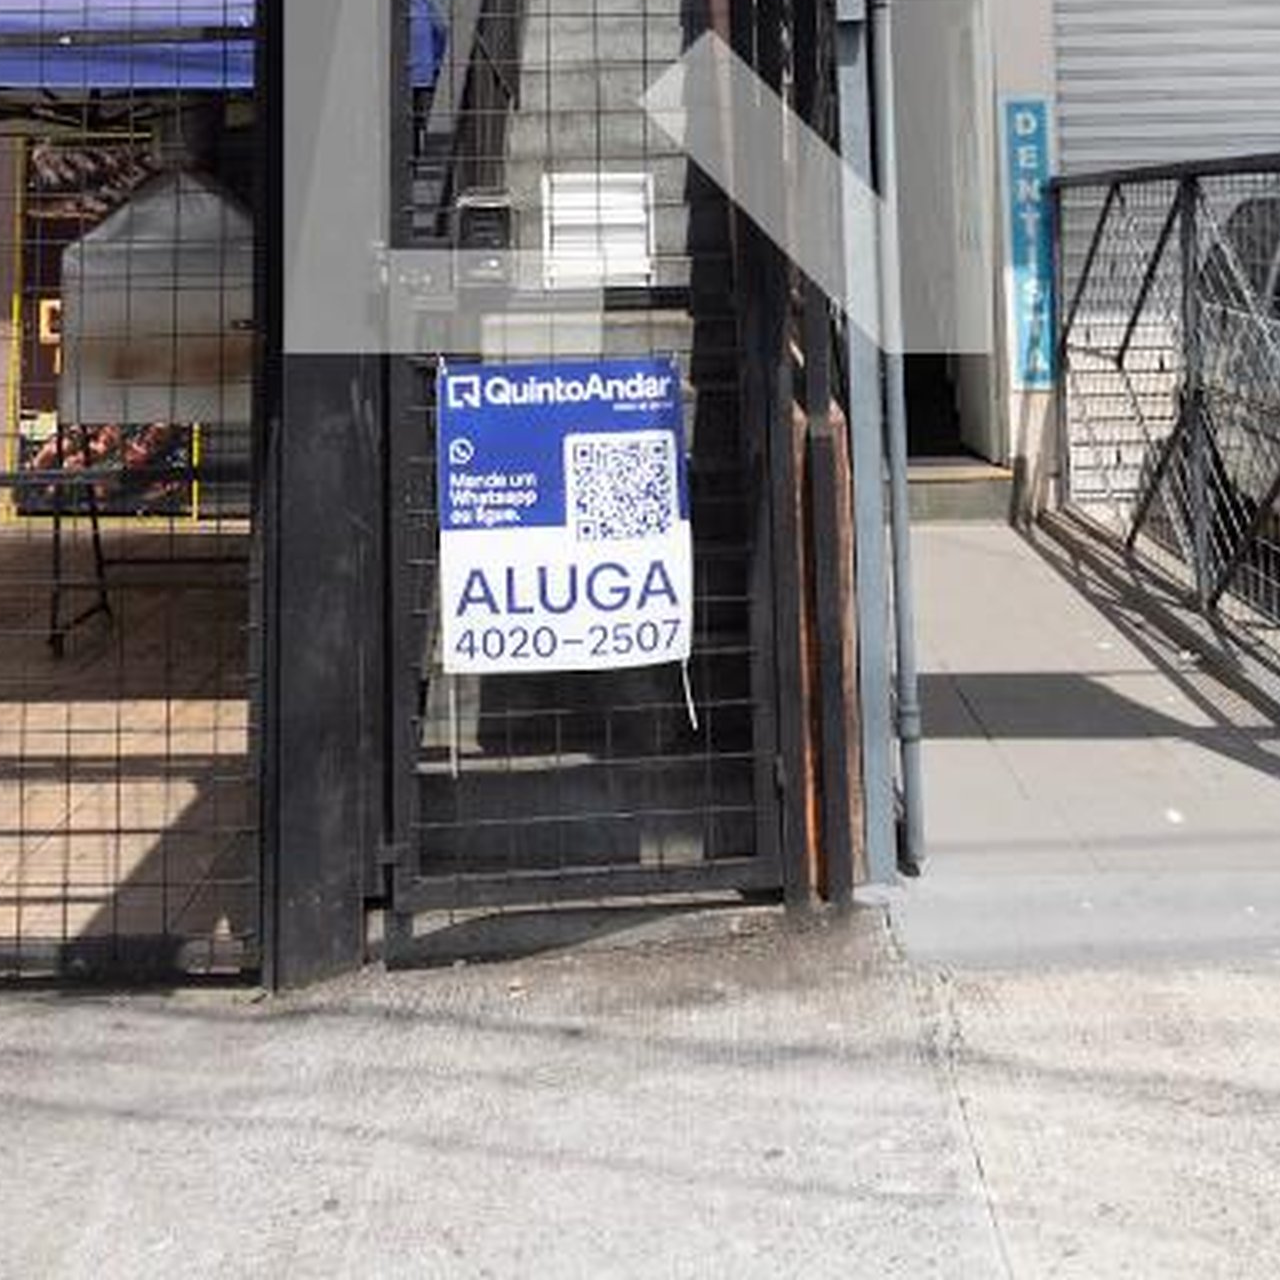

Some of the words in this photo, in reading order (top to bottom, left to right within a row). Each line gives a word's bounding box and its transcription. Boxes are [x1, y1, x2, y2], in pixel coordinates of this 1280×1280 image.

[485, 373, 671, 405] QuintoAndar
[456, 559, 679, 617] ALUGA
[455, 619, 681, 661] 4020-2507
